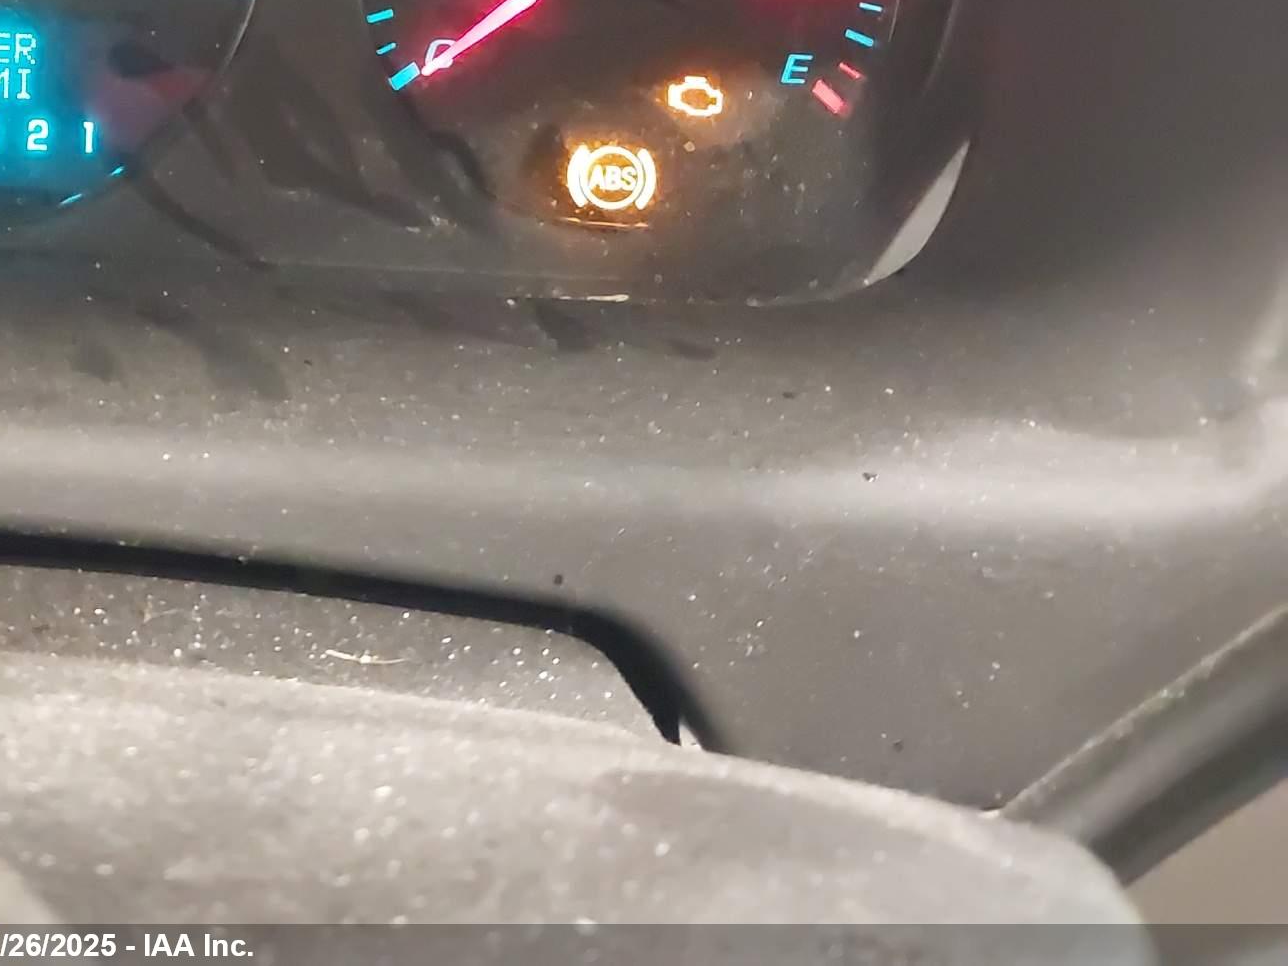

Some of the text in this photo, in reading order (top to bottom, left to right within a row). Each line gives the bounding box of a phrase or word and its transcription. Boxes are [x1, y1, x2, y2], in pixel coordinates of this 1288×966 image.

[780, 53, 813, 84] E
[27, 118, 49, 151] 2
[82, 121, 95, 153] 1
[590, 164, 637, 191] ABS
